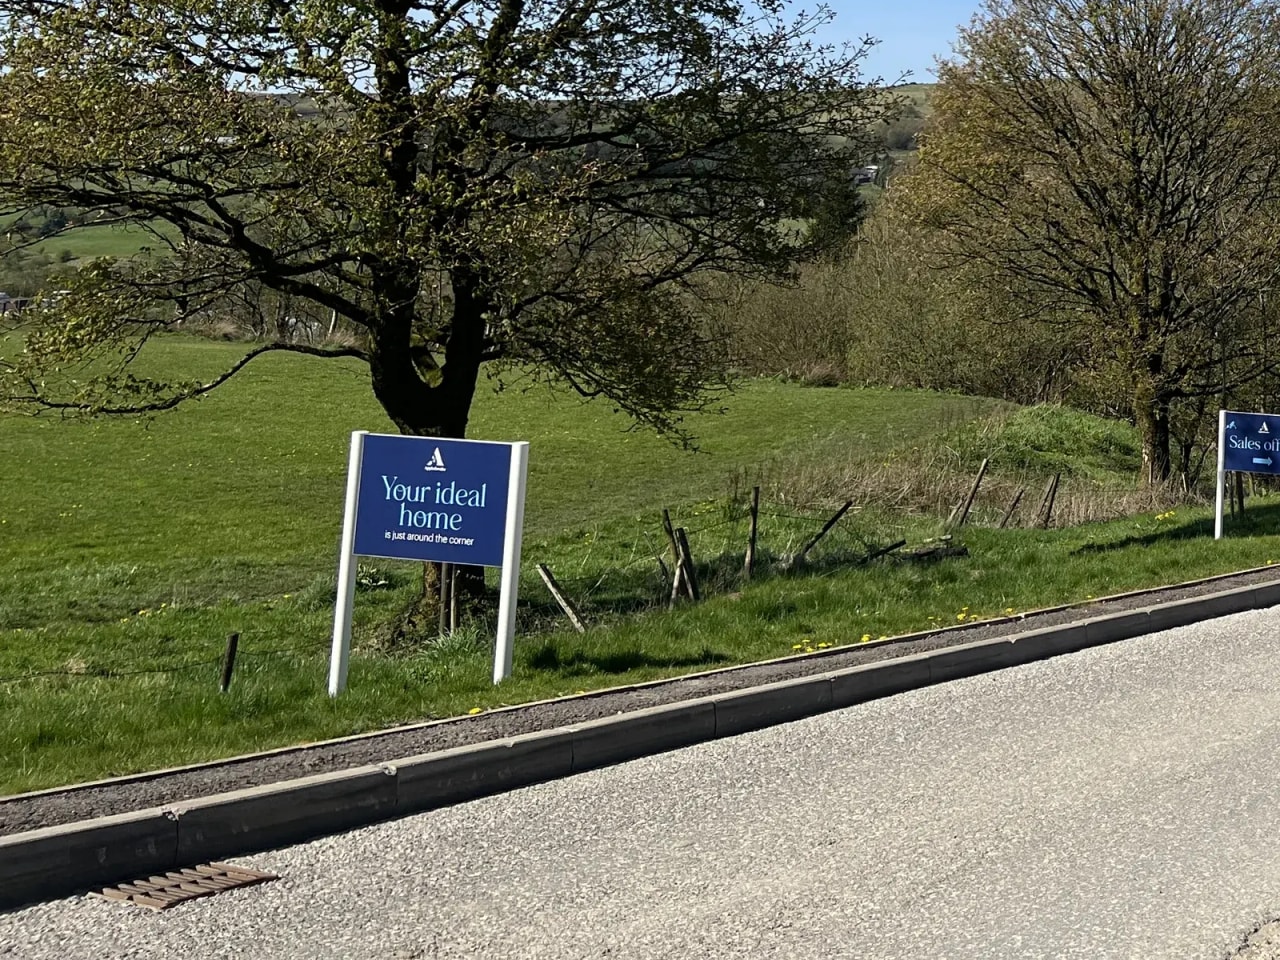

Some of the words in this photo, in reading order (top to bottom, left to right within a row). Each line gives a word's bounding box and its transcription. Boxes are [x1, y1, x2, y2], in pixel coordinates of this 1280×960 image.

[1229, 434, 1261, 451] Sales
[381, 475, 431, 503] Your
[435, 480, 487, 507] ideal
[399, 502, 463, 531] home
[384, 530, 391, 538] is
[391, 530, 406, 541] just
[406, 533, 434, 543] around
[435, 534, 448, 544] the
[448, 536, 474, 546] corner
